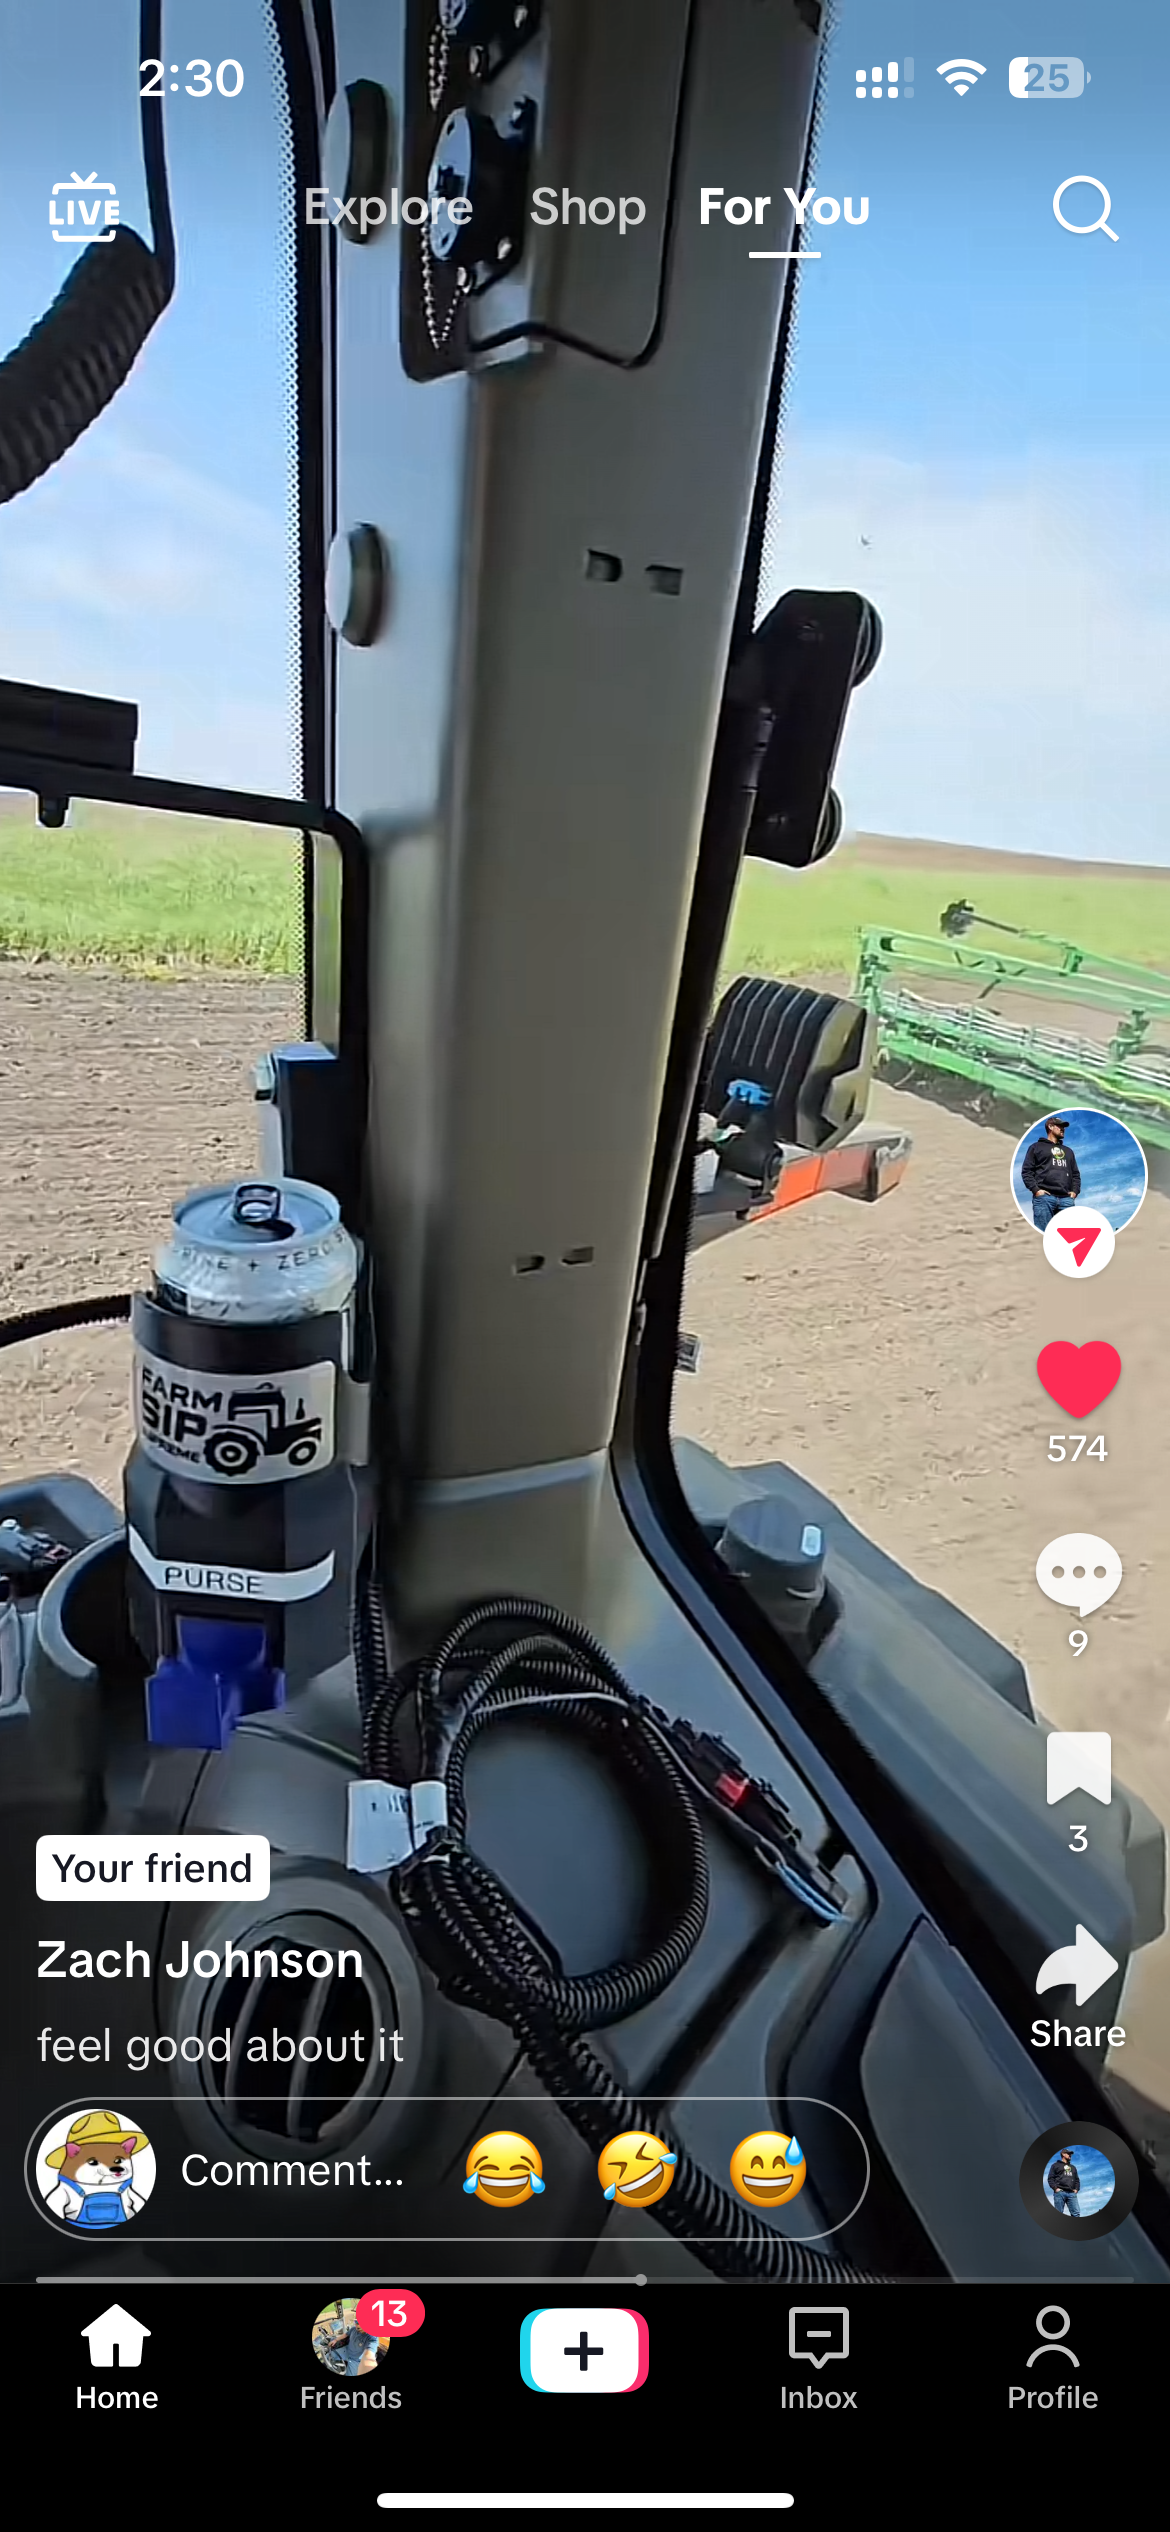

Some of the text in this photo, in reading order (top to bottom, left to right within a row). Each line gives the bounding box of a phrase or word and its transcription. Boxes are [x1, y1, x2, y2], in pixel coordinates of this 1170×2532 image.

[142, 1364, 223, 1413] FARM
[142, 1389, 208, 1442] SIP
[164, 1567, 264, 1595] PURSE
